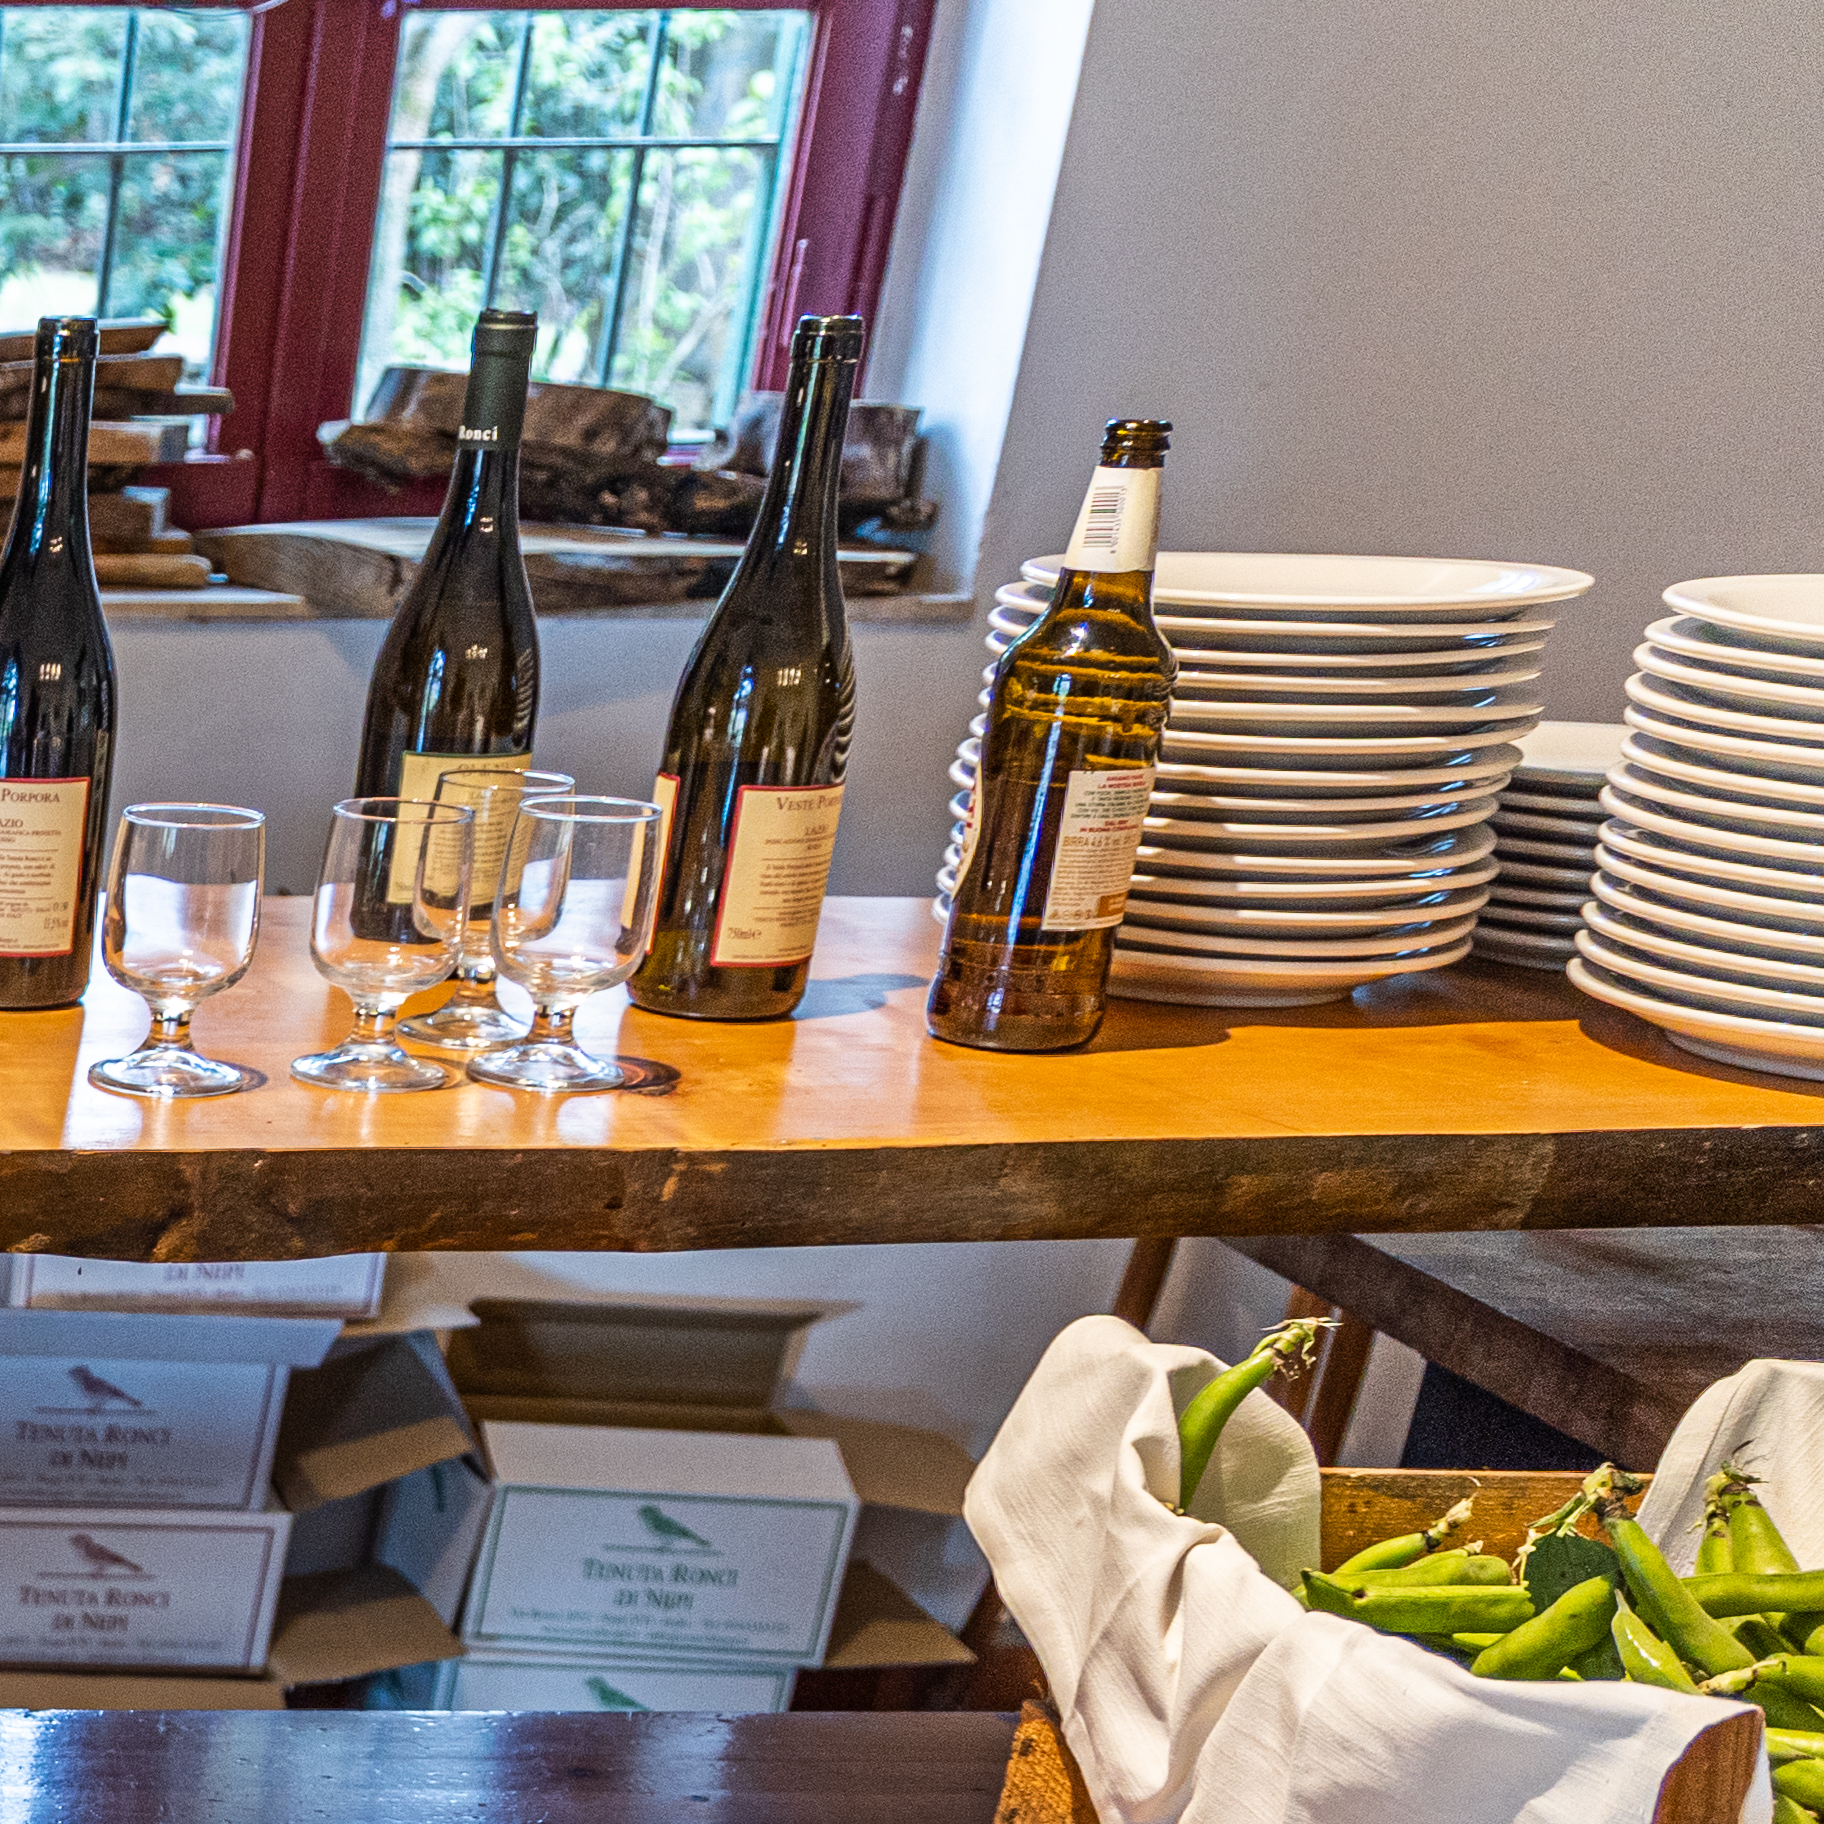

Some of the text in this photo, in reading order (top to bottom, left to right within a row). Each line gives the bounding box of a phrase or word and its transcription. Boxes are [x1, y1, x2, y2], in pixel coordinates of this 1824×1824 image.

[458, 425, 498, 441] Ronci
[1, 788, 60, 803] PORPORA
[776, 797, 814, 811] VESTE
[16, 1421, 172, 1445] TENUTA RONCI
[79, 1450, 129, 1469] NEPI
[581, 1558, 739, 1586] TENUTA RONCI
[20, 1585, 171, 1607] TENUTA RONCI
[614, 1587, 694, 1610] DI NEPI
[81, 1611, 129, 1632] NEPI
